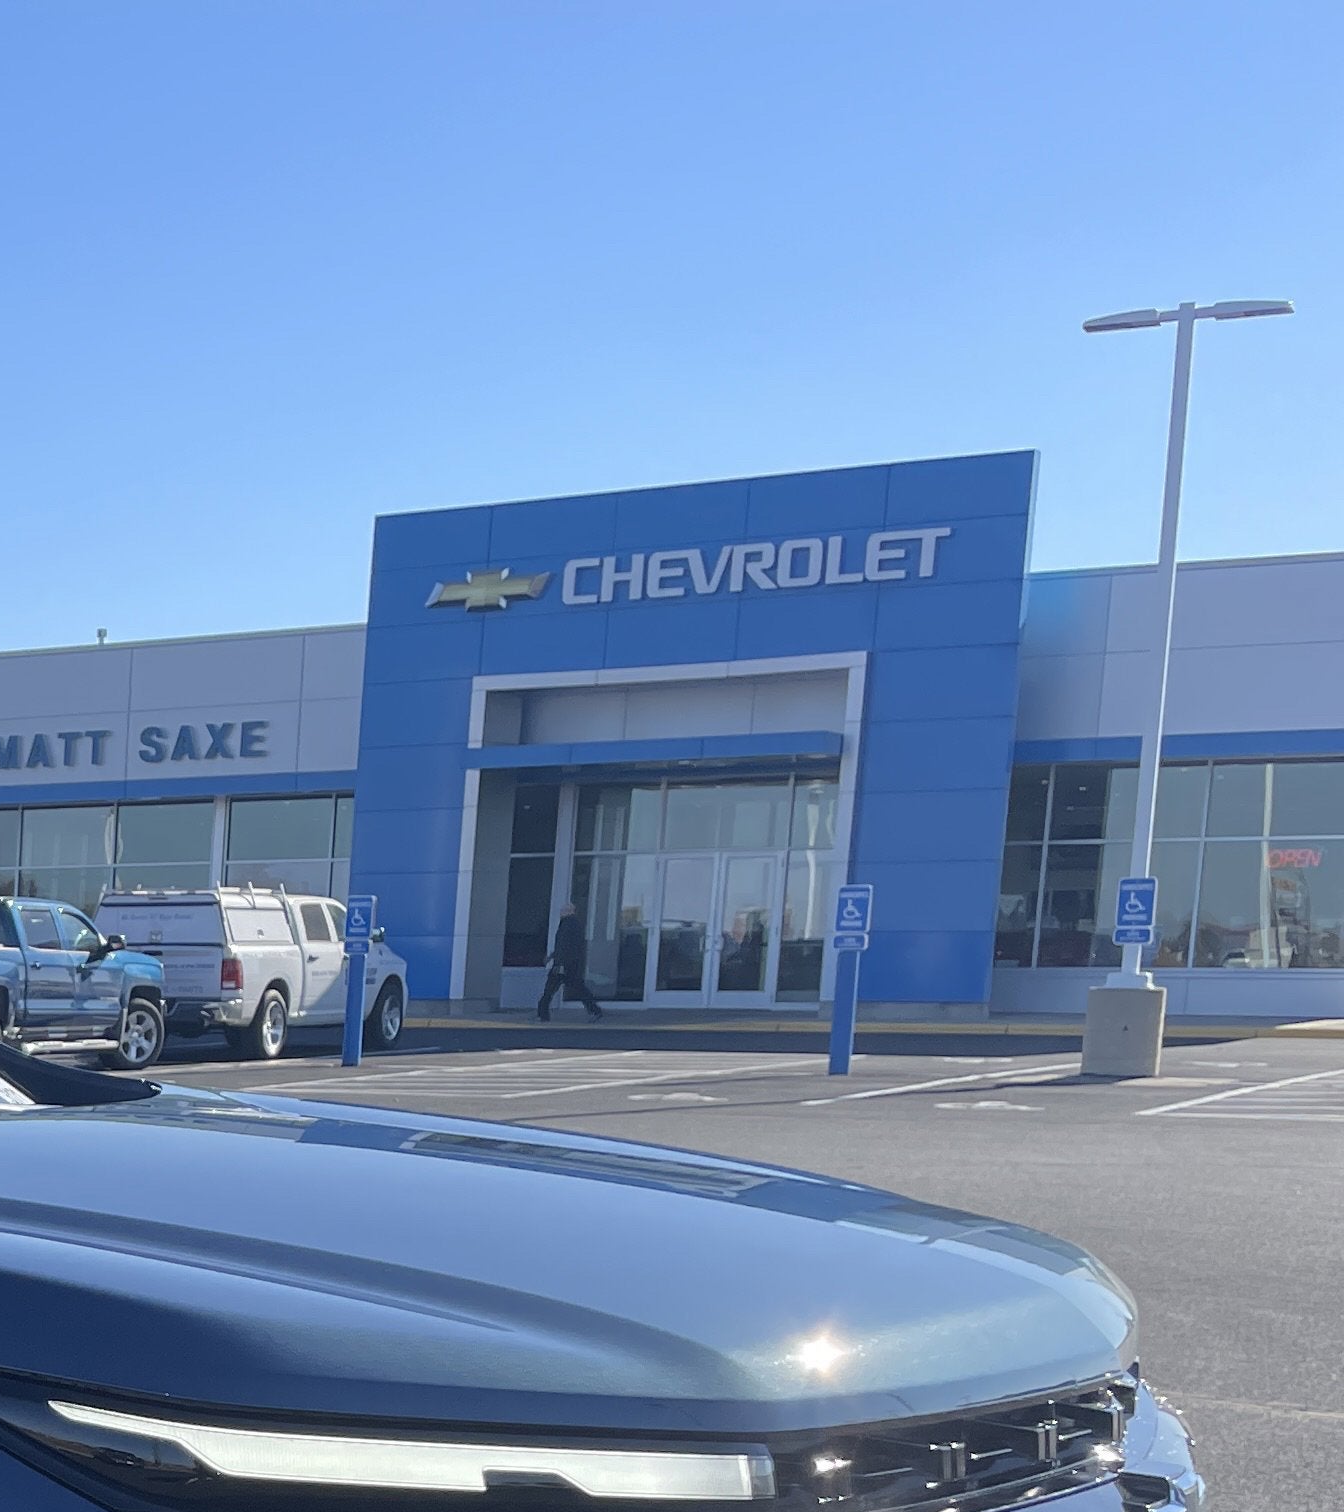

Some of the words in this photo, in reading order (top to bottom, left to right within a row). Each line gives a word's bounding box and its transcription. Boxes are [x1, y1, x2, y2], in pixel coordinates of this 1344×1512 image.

[561, 526, 952, 605] CHEVROLET
[138, 719, 270, 763] SAXE
[1268, 847, 1322, 869] OPEN
